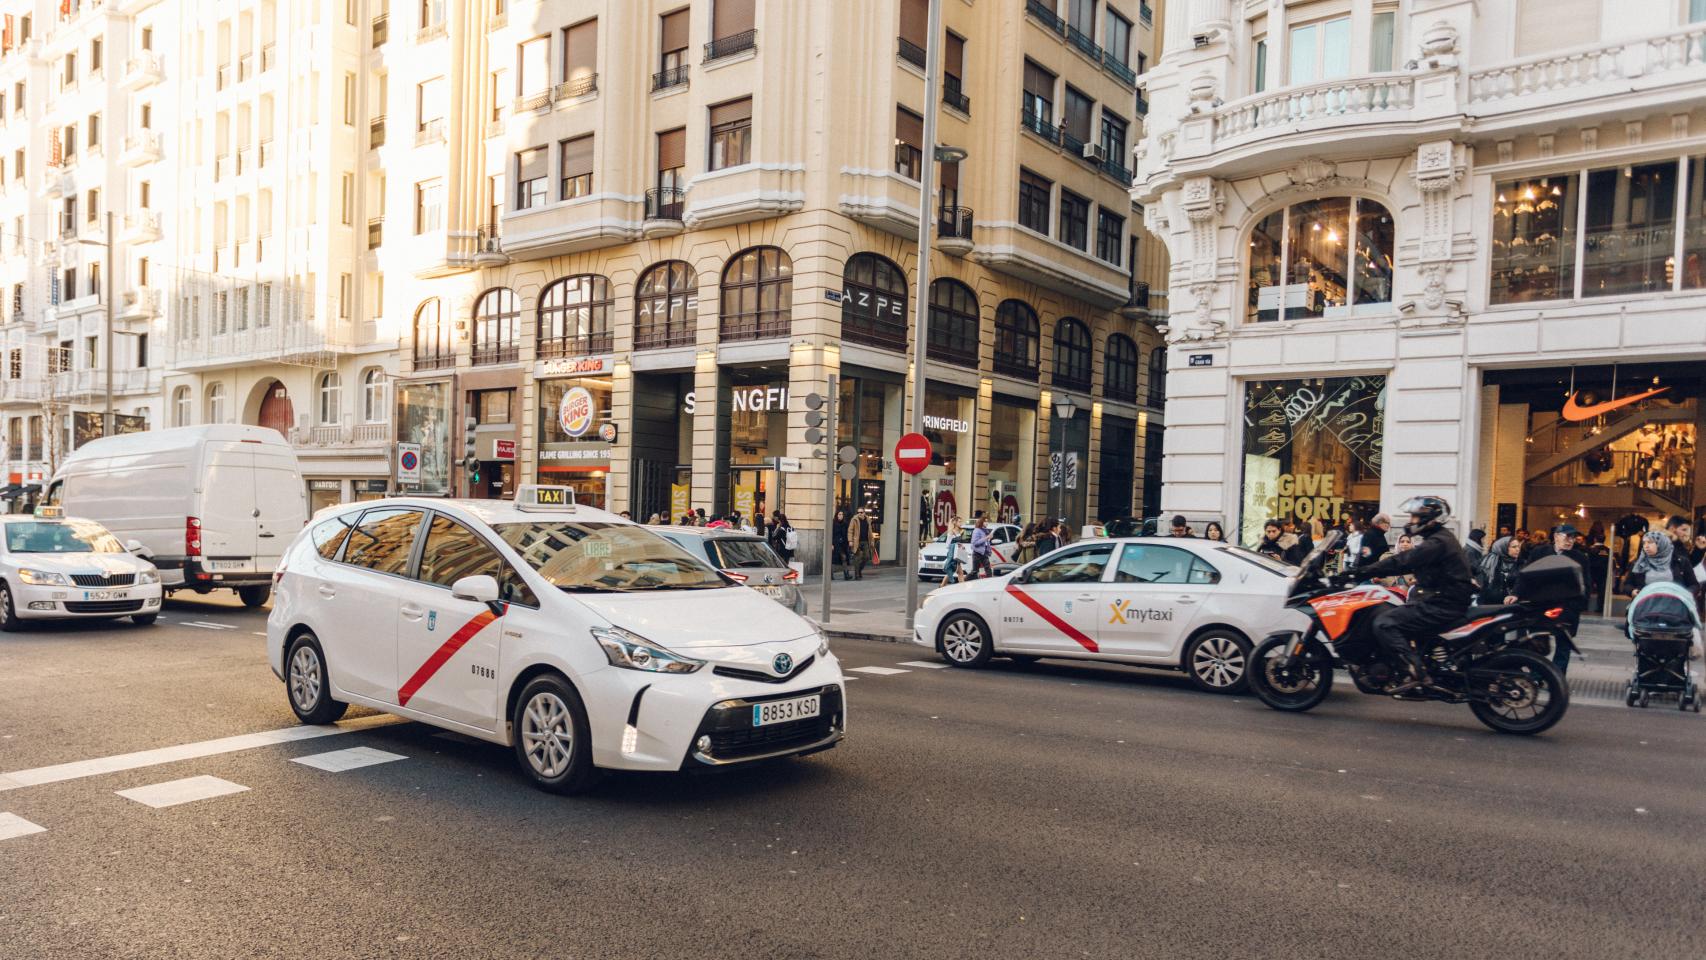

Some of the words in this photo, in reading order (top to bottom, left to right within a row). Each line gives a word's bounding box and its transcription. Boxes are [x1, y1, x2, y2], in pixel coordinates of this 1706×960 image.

[543, 361, 577, 374] BURGER
[577, 360, 602, 371] KING
[563, 397, 588, 415] BURGER
[564, 405, 589, 426] KING
[1278, 473, 1334, 497] GIVE
[538, 490, 563, 503] TAXI
[1266, 496, 1350, 521] SPORT.
[1126, 607, 1172, 623] mytaxi
[762, 702, 793, 722] 8853
[797, 698, 817, 717] KSD
